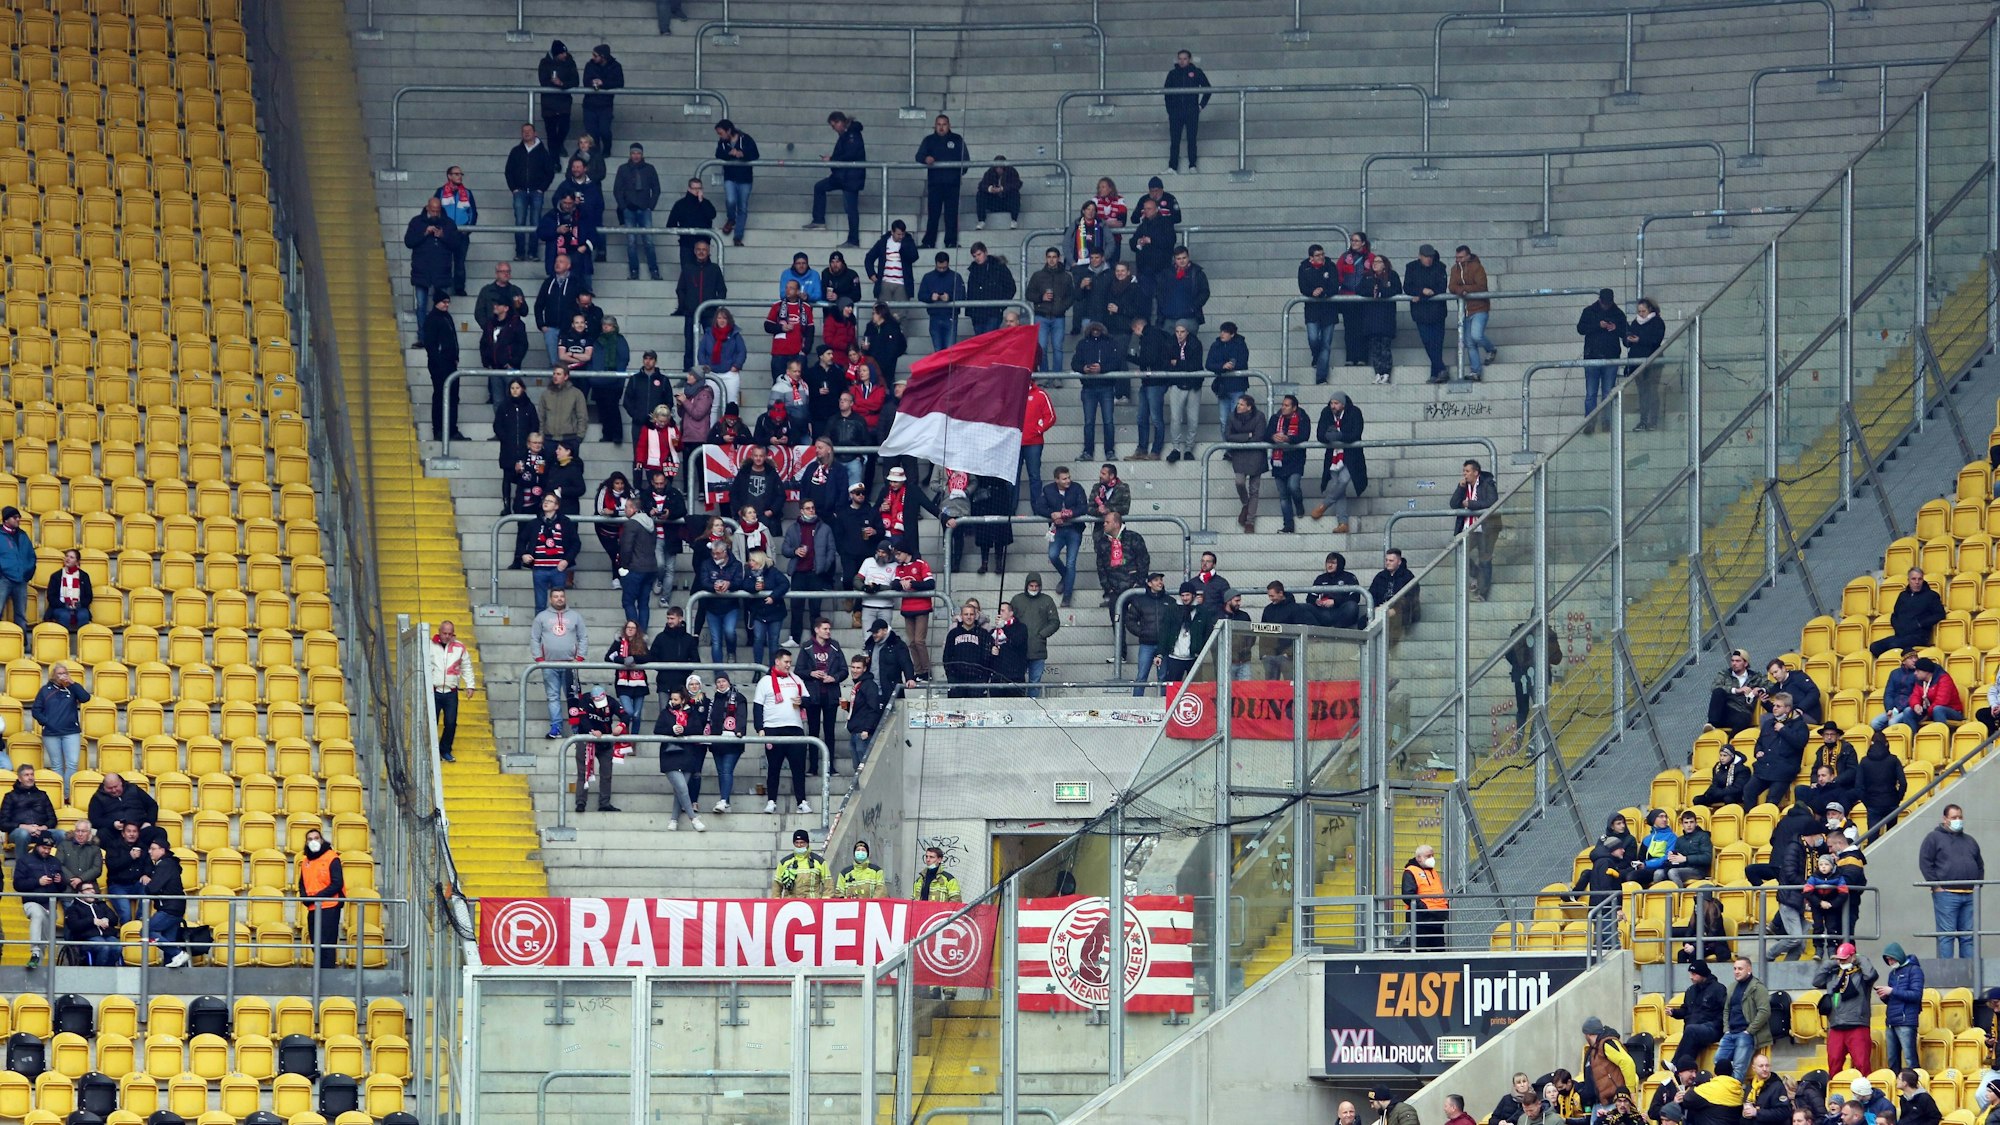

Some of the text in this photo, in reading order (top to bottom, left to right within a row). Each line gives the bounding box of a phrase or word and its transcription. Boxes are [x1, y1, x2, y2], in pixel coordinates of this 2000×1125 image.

[569, 897, 908, 968] RATINGEN
[1375, 970, 1550, 1017] EAST print
[1341, 1045, 1434, 1063] DIGITALDRUCK
